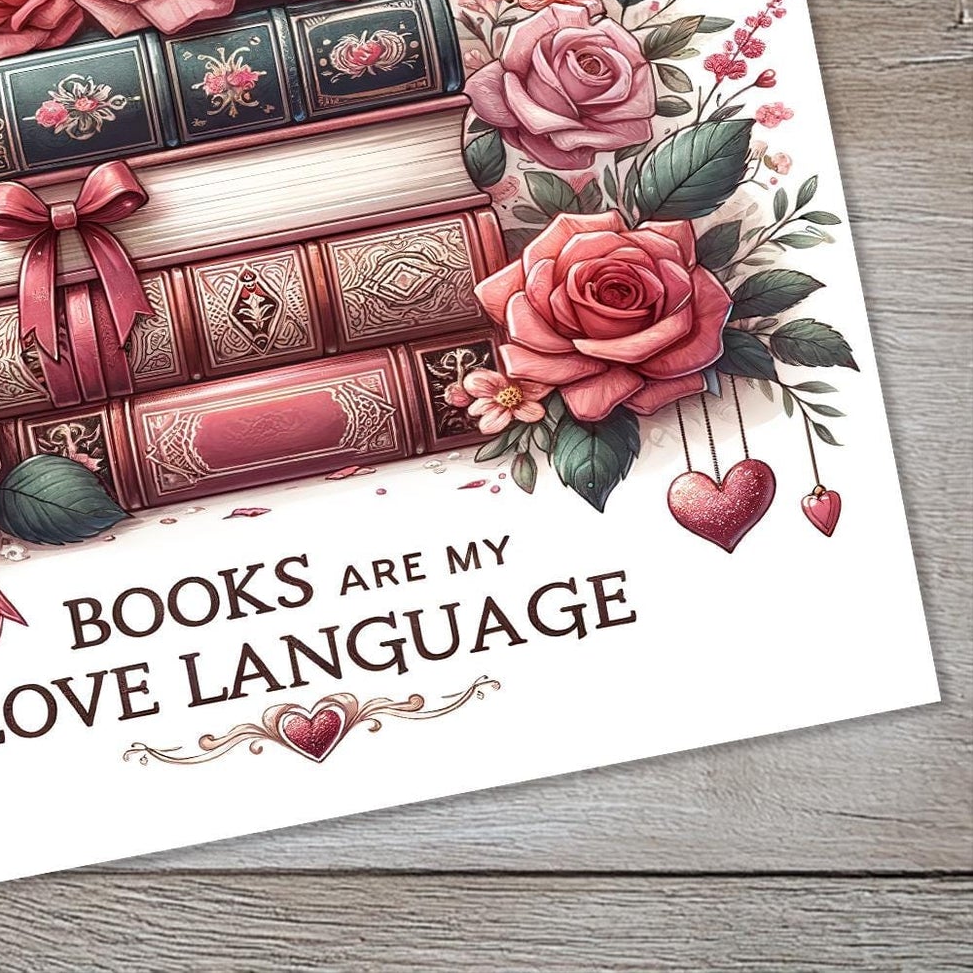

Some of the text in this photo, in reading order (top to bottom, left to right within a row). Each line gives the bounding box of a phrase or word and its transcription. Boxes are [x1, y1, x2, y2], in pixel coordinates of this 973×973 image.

[63, 535, 510, 651] BOOKS ARE MY
[178, 570, 637, 708] LANGUAGE
